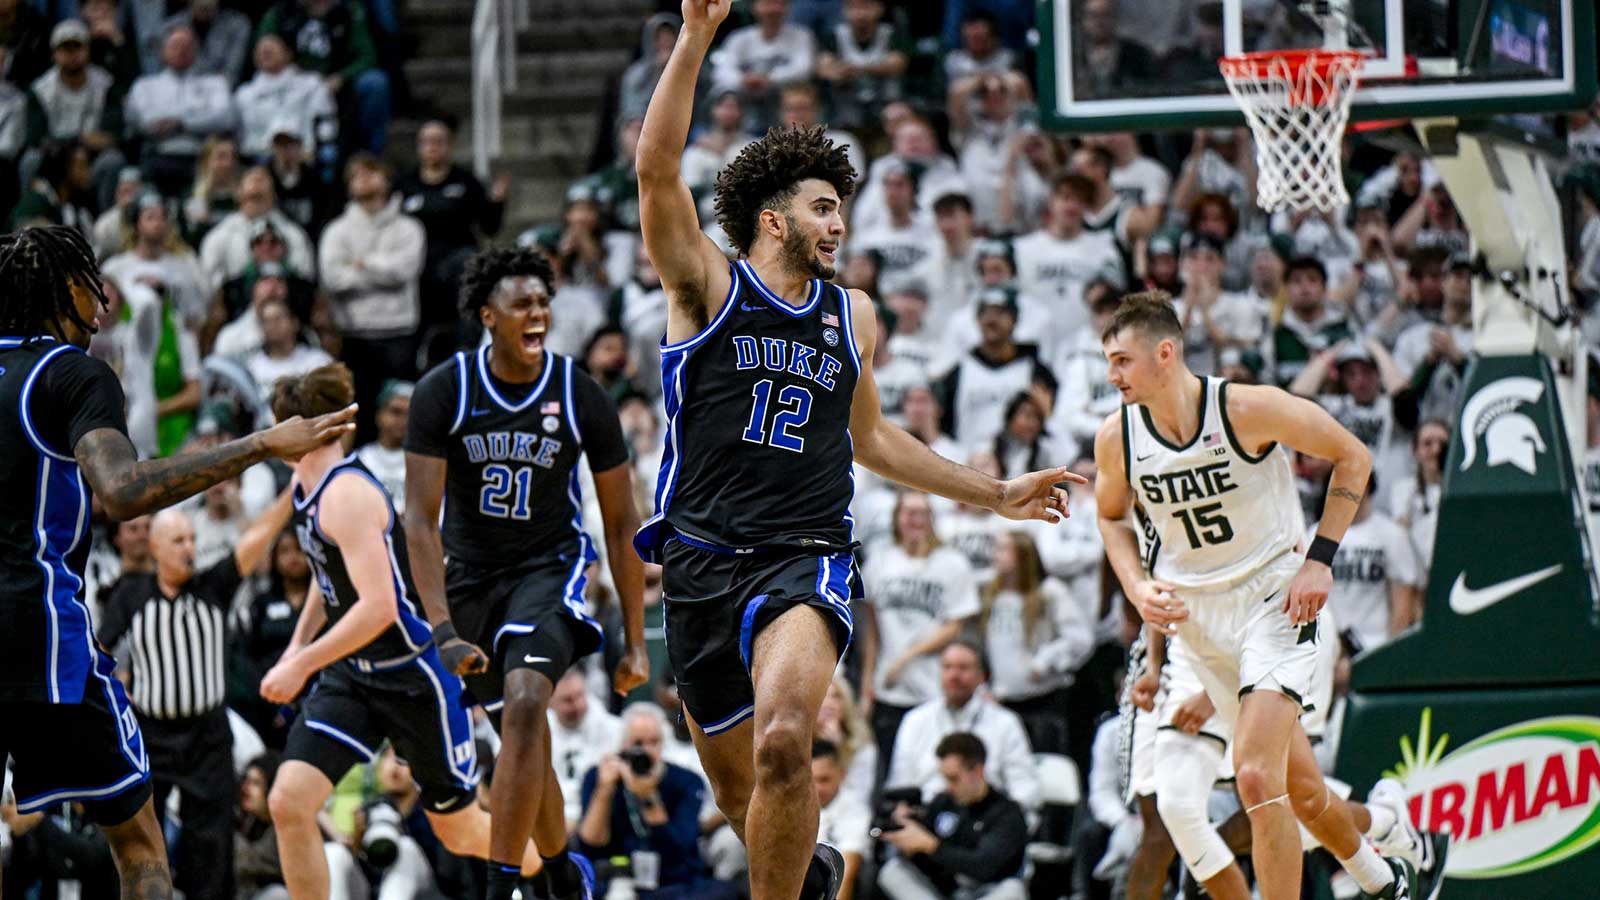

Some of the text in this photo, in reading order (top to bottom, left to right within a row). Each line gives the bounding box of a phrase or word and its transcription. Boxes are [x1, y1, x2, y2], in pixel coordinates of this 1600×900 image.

[732, 335, 842, 391] DUKE
[742, 379, 813, 453] 12
[462, 431, 562, 469] DUKE
[480, 463, 532, 520] 21
[1139, 460, 1239, 504] STATE
[1171, 501, 1234, 549] 15
[1407, 746, 1600, 844] IBMAN
